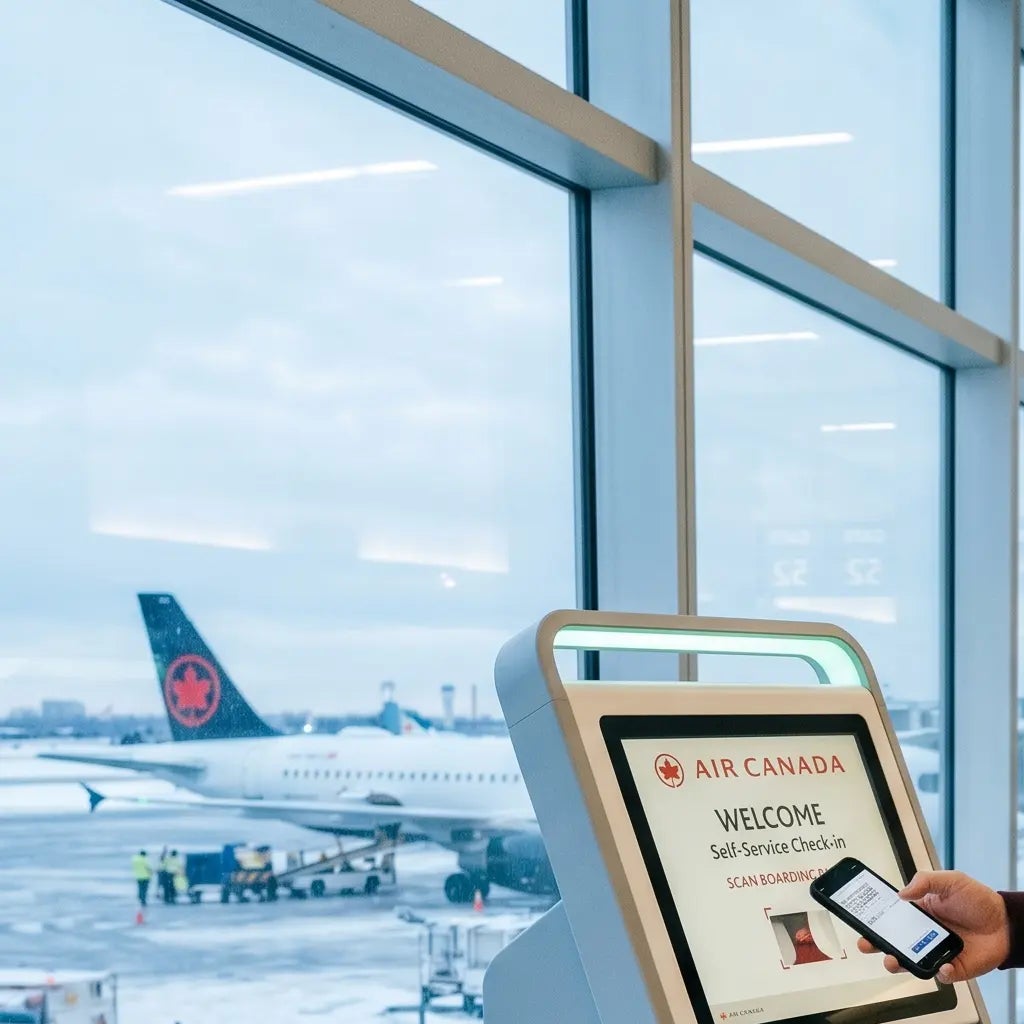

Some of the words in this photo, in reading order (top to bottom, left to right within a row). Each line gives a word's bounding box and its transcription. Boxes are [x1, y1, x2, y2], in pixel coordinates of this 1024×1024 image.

[696, 758, 739, 779] AIR
[743, 755, 846, 777] CANADA
[714, 803, 826, 833] WELCOME
[710, 840, 790, 860] Self-Service
[726, 875, 758, 889] SCAN
